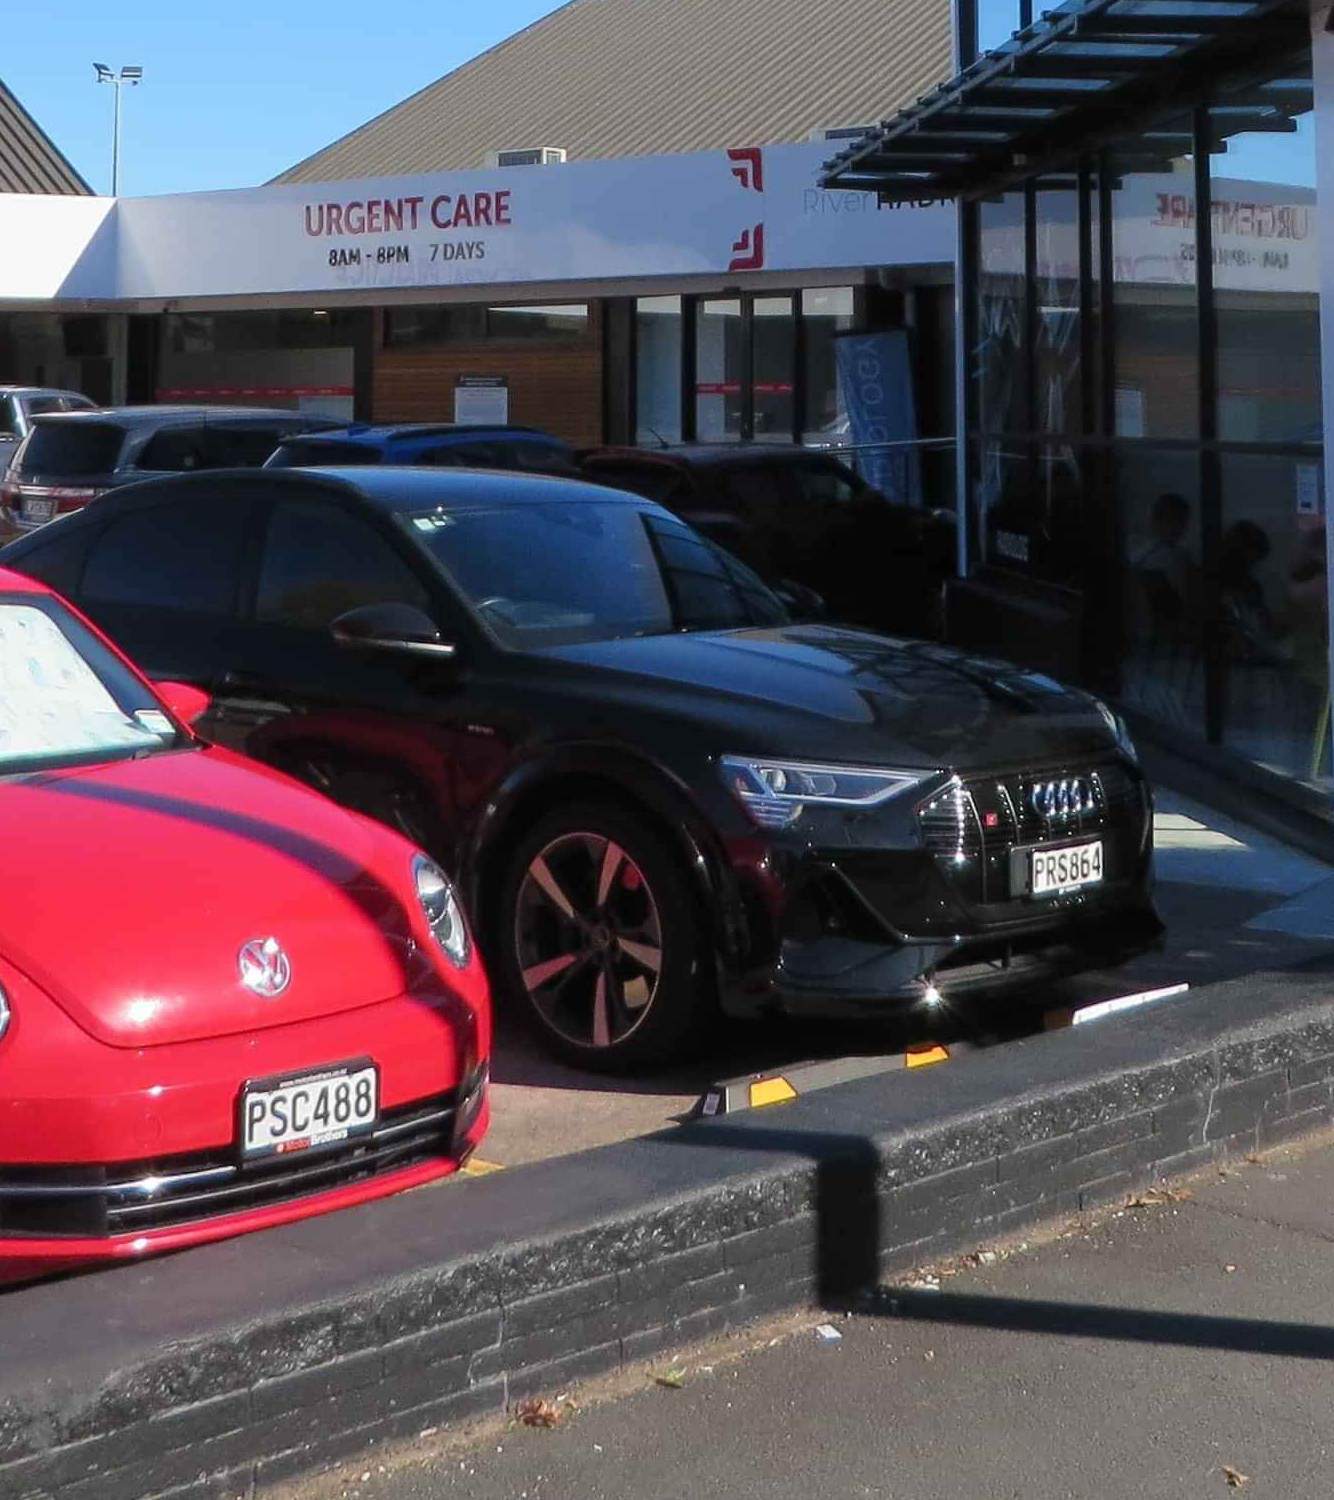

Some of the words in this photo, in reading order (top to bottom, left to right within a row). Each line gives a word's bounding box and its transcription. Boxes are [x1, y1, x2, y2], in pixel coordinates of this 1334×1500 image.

[304, 196, 425, 237] URGENT
[430, 189, 512, 230] CARE
[328, 247, 362, 267] 8AM
[376, 244, 410, 265] 8PM
[429, 243, 439, 262] 7
[442, 241, 485, 261] DAYS
[1033, 846, 1102, 889] PRS864
[247, 1076, 372, 1144] PSC488
